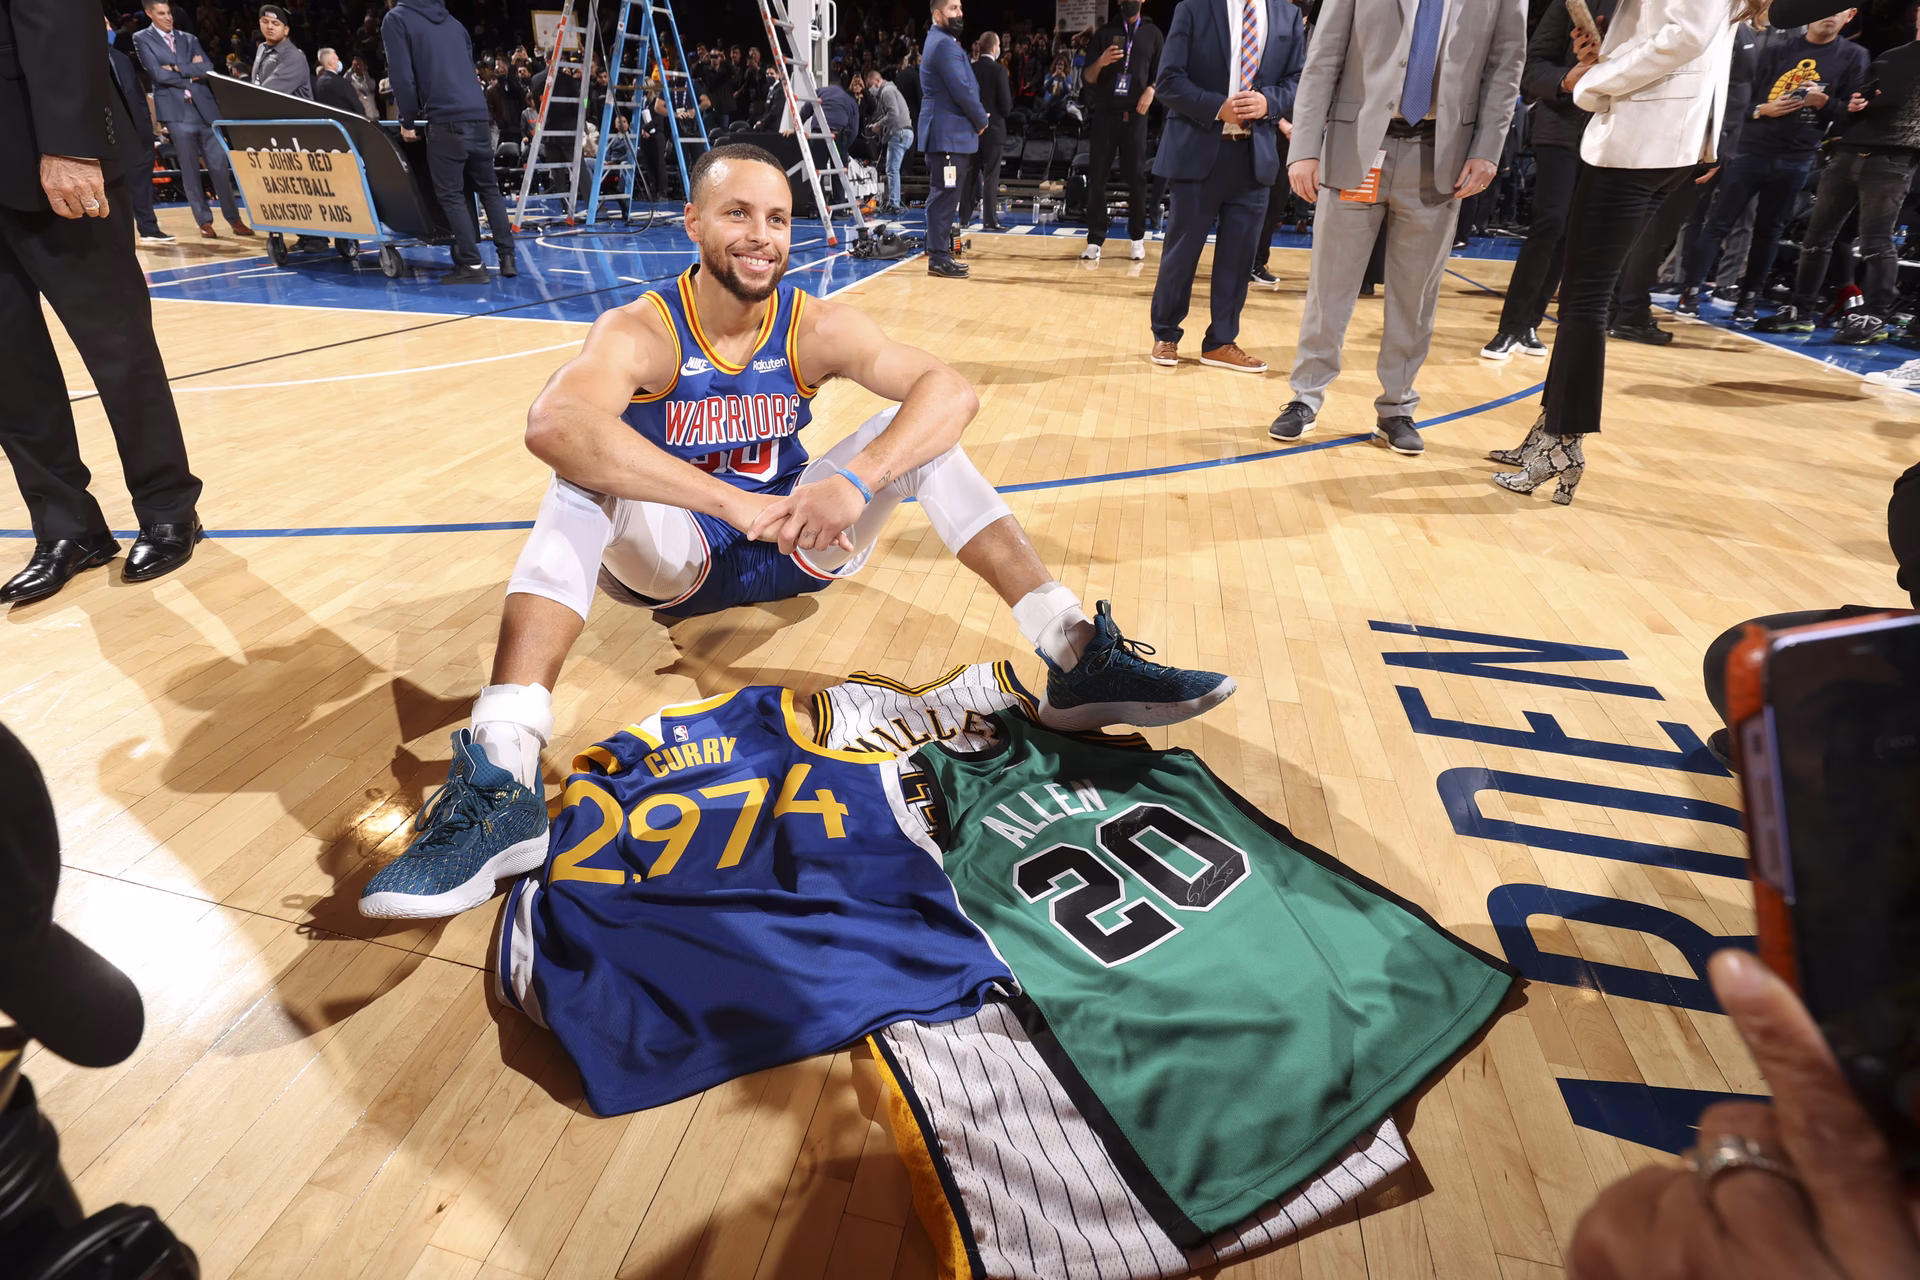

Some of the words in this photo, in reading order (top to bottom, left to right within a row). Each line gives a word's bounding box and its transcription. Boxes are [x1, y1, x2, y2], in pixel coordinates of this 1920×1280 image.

[246, 152, 262, 169] ST
[269, 152, 303, 171] JOHNS
[307, 153, 333, 172] RED
[262, 176, 336, 197] BASKETBALL
[260, 203, 313, 221] BACKSTOP
[318, 203, 352, 223] PADS
[686, 356, 709, 369] NIKE
[752, 357, 788, 371] Rakuten
[665, 393, 800, 446] WARRIORS
[843, 709, 1000, 757] MILLE
[643, 736, 738, 779] CURRY
[981, 778, 1108, 849] ALLEN
[1012, 801, 1252, 968] 20
